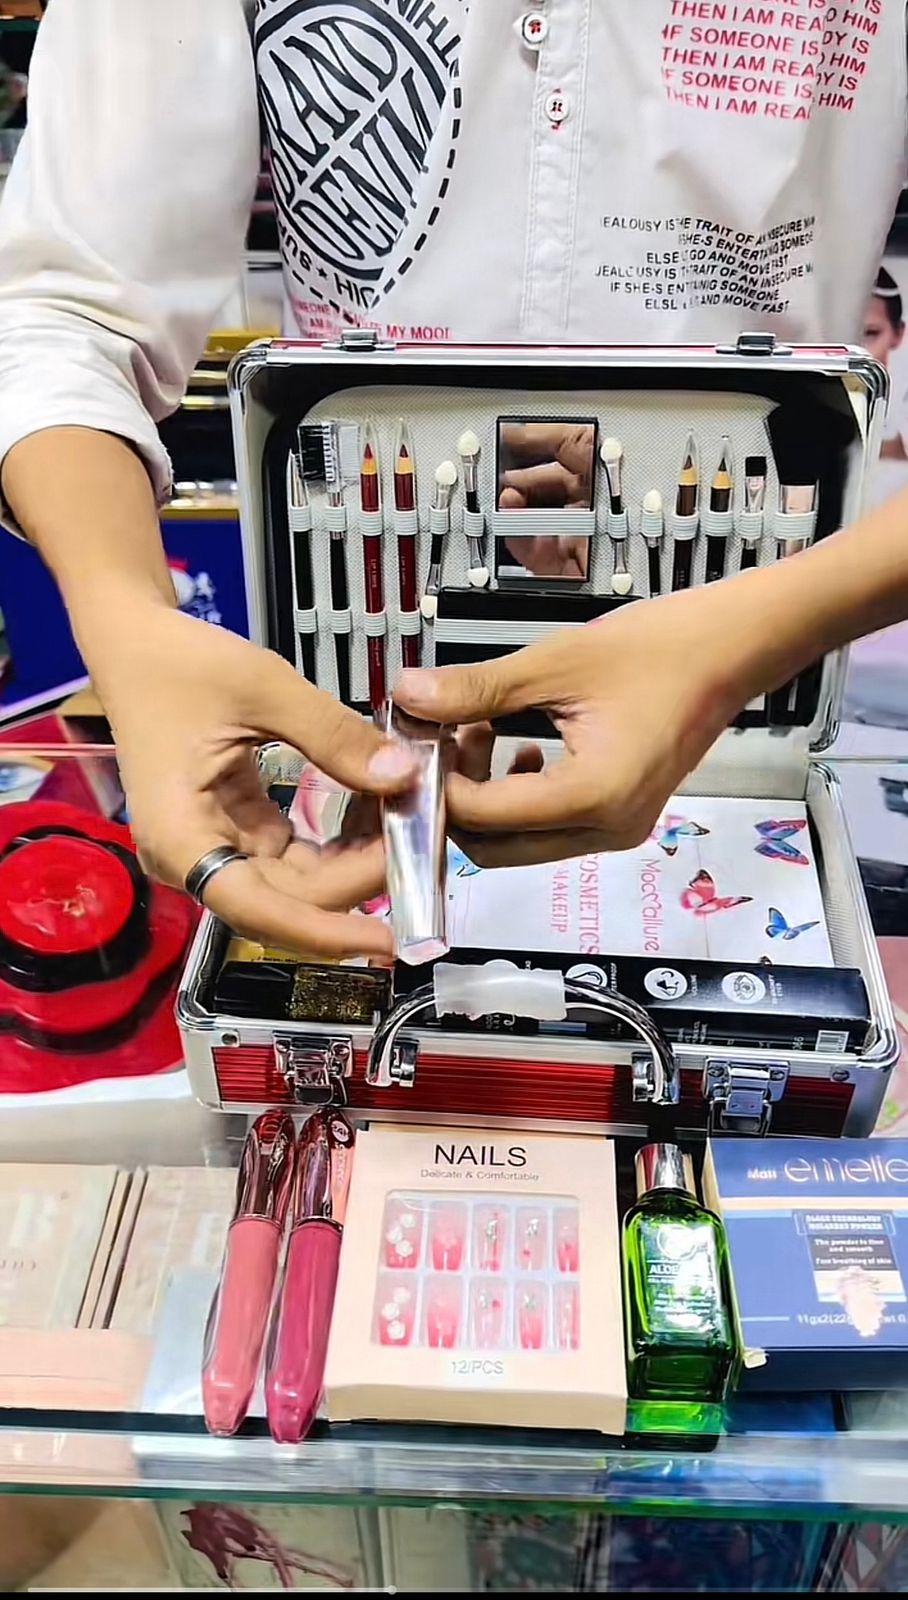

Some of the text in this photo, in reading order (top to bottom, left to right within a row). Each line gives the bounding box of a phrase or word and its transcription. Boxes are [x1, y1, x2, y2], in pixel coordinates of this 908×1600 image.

[669, 0, 725, 21] THEN
[732, 6, 738, 22] I
[742, 8, 774, 26] AM
[842, 9, 880, 36] HIM
[689, 27, 795, 52] SOMEONE
[801, 40, 819, 56] IS
[852, 37, 870, 55] IS
[662, 47, 716, 67] THEN
[723, 52, 728, 68] I
[733, 54, 766, 73] AM
[829, 52, 867, 75] HIM
[682, 71, 786, 97] SOMEONE
[793, 84, 813, 99] IS
[838, 74, 859, 91] IS
[666, 87, 709, 110] THEN
[725, 98, 758, 115] AM
[817, 92, 854, 111] HIM
[600, 216, 661, 232] EALOUSY
[696, 219, 733, 237] TRAIT
[735, 232, 755, 245] OF
[647, 251, 680, 265] ELSE
[708, 251, 736, 265] AND
[737, 260, 770, 275] MOVE
[665, 268, 677, 280] IS
[720, 267, 738, 279] OF
[738, 275, 760, 288] AN
[610, 282, 620, 293] IF
[720, 280, 779, 301] SOMEONE
[722, 295, 760, 312] MOVE
[387, 325, 406, 338] MY
[579, 855, 600, 955] OSMETICS
[434, 1144, 527, 1167] NAILS
[420, 1169, 462, 1180] Delicate
[477, 1171, 539, 1181] Comfortable
[451, 1361, 504, 1375] 12/PCS
